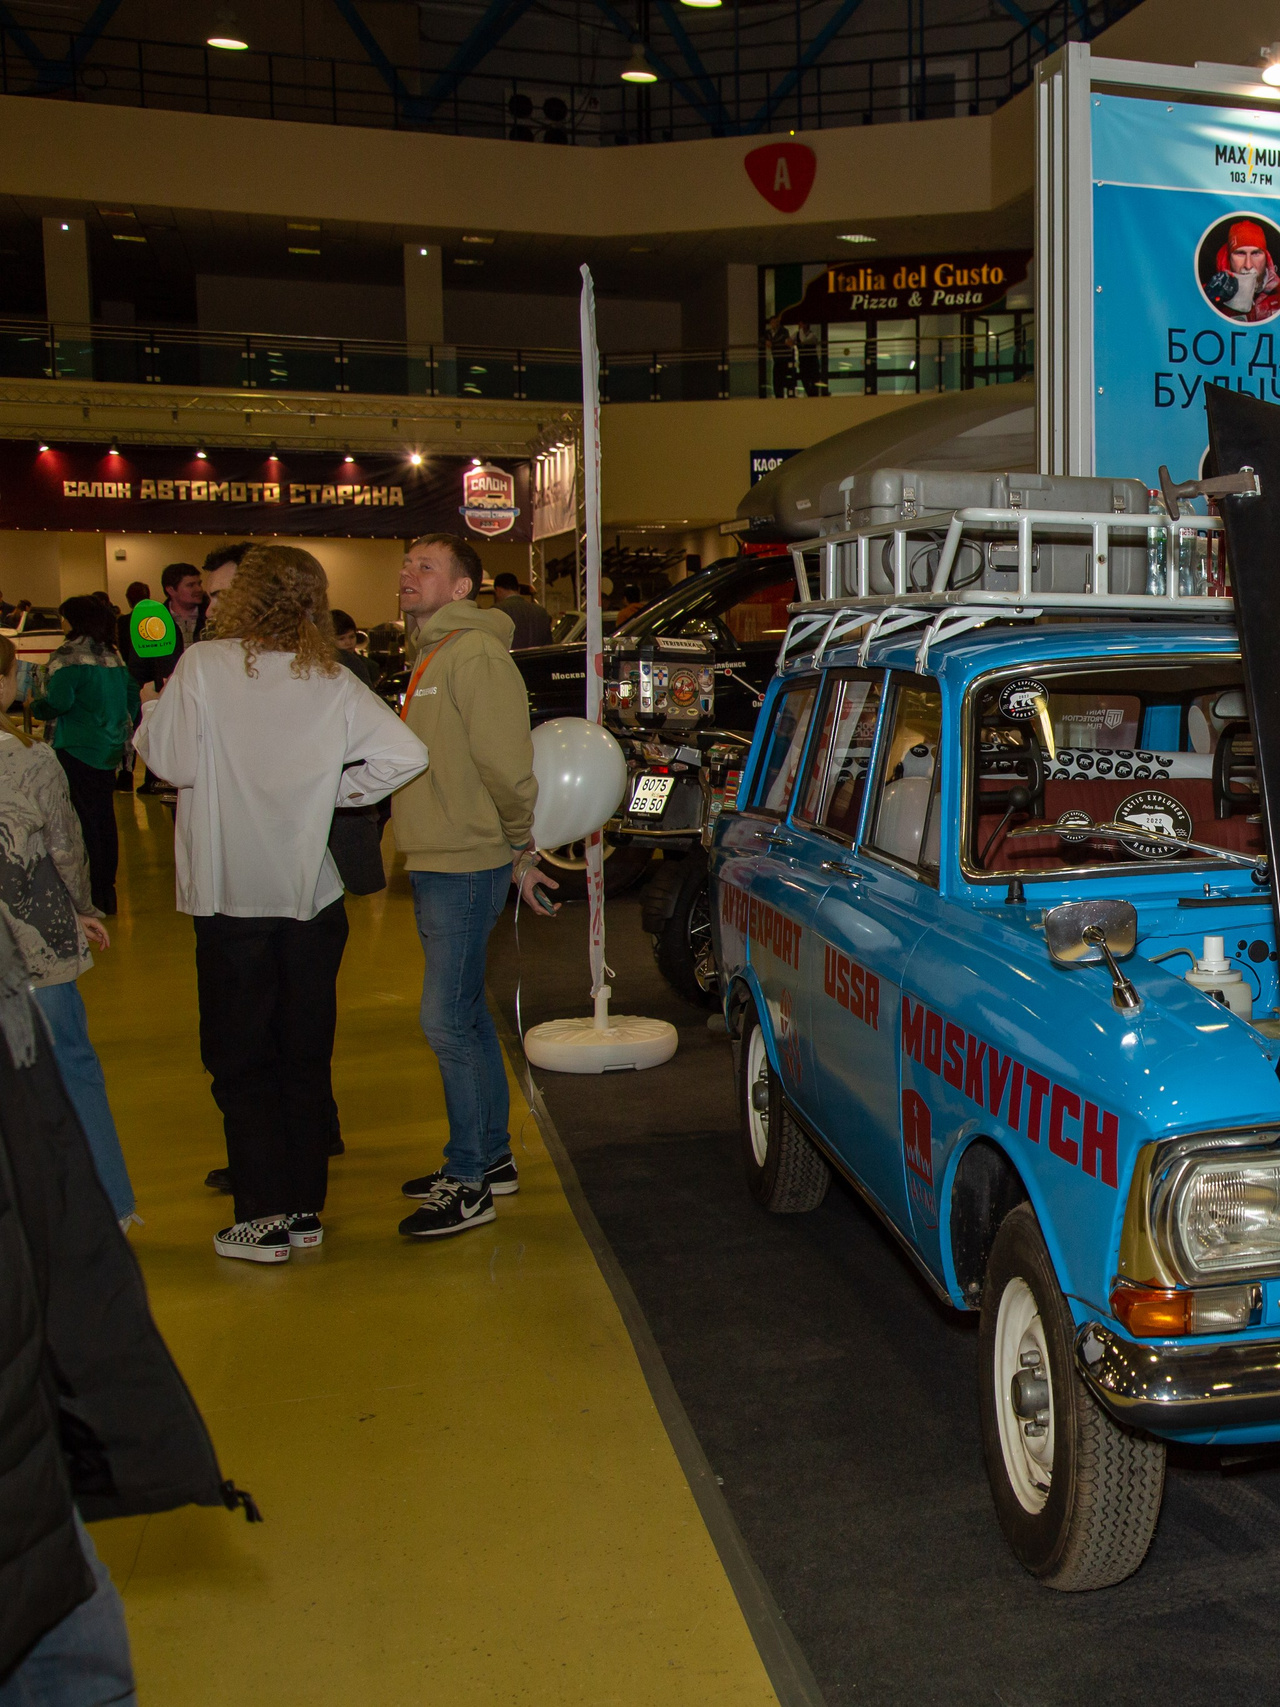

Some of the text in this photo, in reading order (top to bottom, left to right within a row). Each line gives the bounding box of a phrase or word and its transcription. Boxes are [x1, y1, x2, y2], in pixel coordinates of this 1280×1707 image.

[1260, 174, 1272, 185] FM
[828, 263, 1003, 293] Italia del Gusto
[850, 290, 983, 310] Pizza & Pasta
[471, 476, 508, 491] САЛОН
[63, 479, 404, 506] САЛОН АВТОМОТО СТАРИНА
[552, 672, 586, 681] Москва
[642, 779, 668, 791] 8075
[649, 799, 663, 811] 50
[722, 883, 1119, 1190] AVTOEXPORT USSR MOSKVITCH
